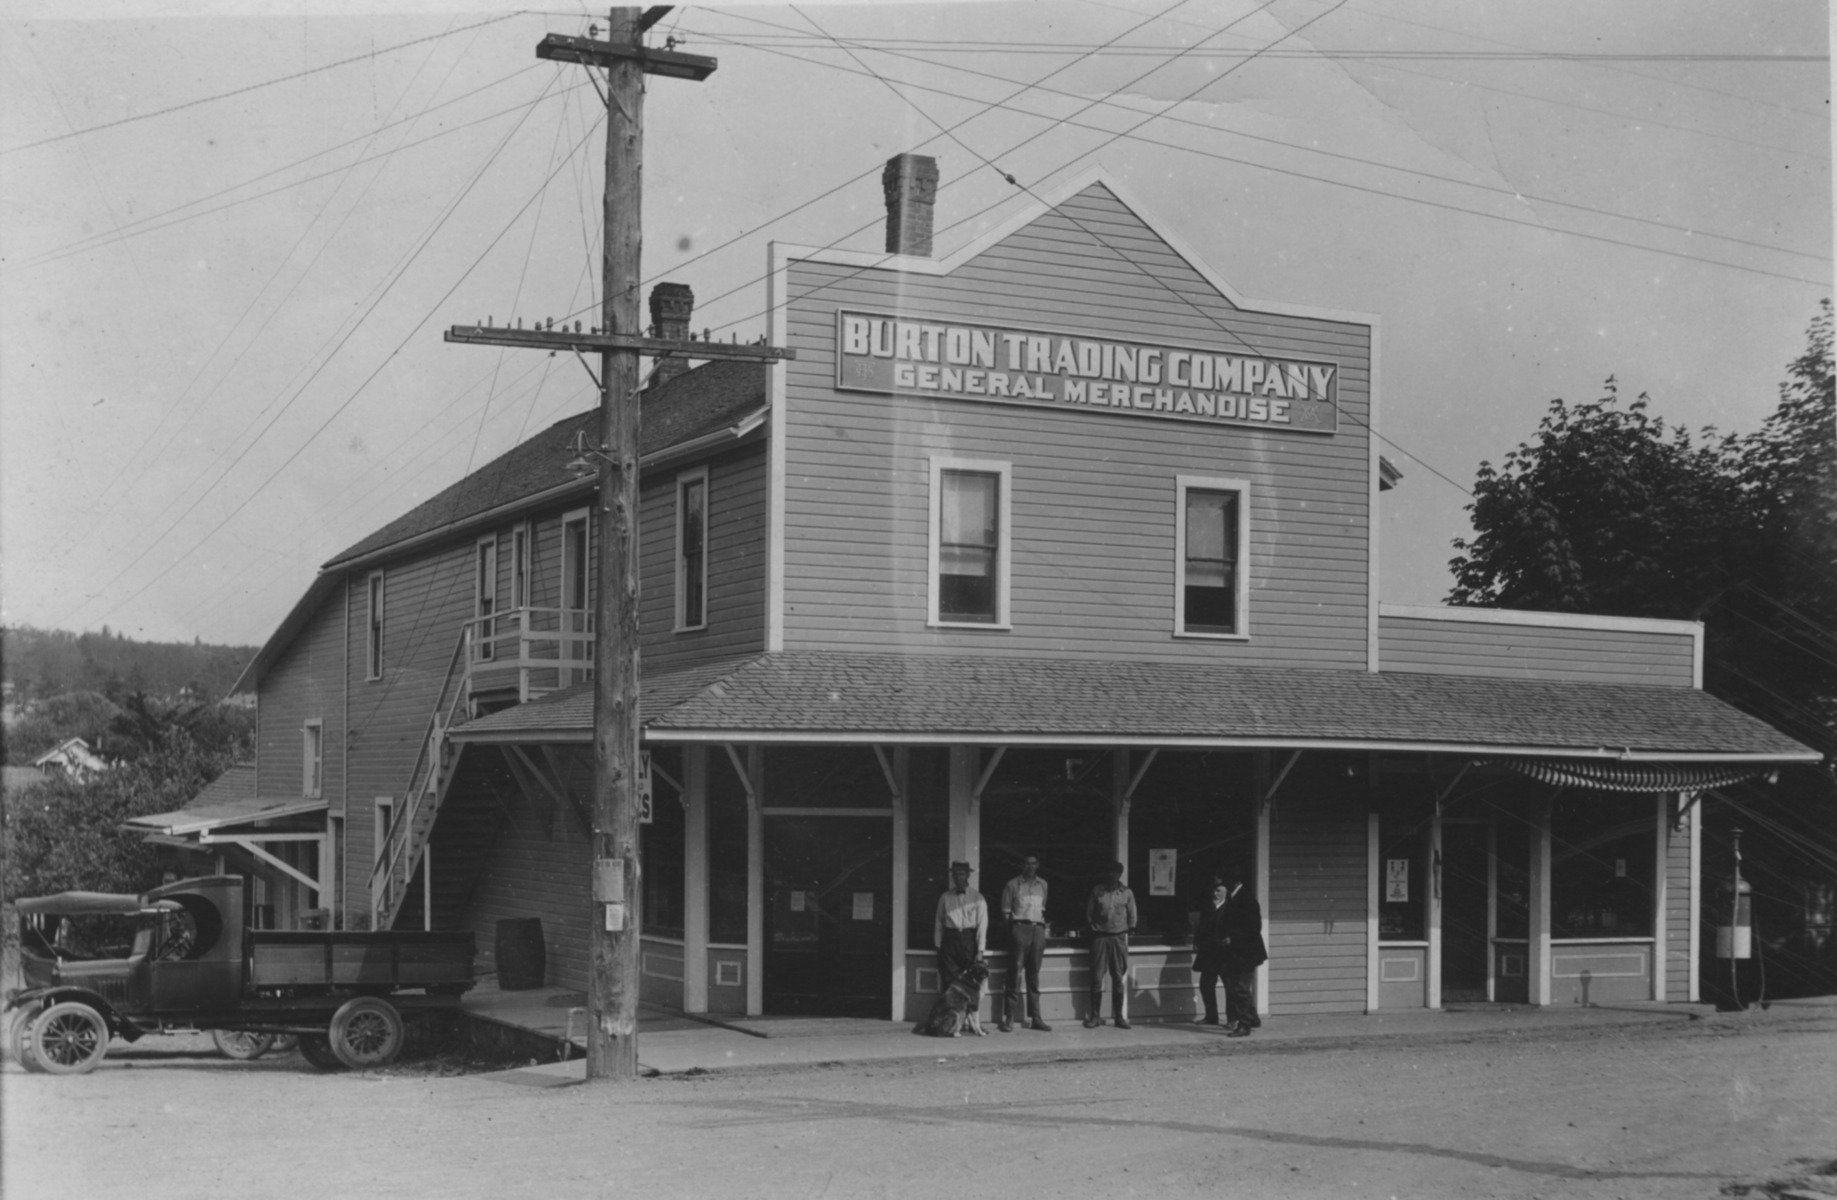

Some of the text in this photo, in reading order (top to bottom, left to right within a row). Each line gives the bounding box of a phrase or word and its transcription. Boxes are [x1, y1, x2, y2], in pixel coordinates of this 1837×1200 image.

[844, 316, 996, 370] BURTON
[1003, 333, 1163, 385] TRADING
[1168, 351, 1336, 401] COMPANY
[895, 363, 1056, 400] GENERAL
[1064, 379, 1291, 424] MERCHANDISE
